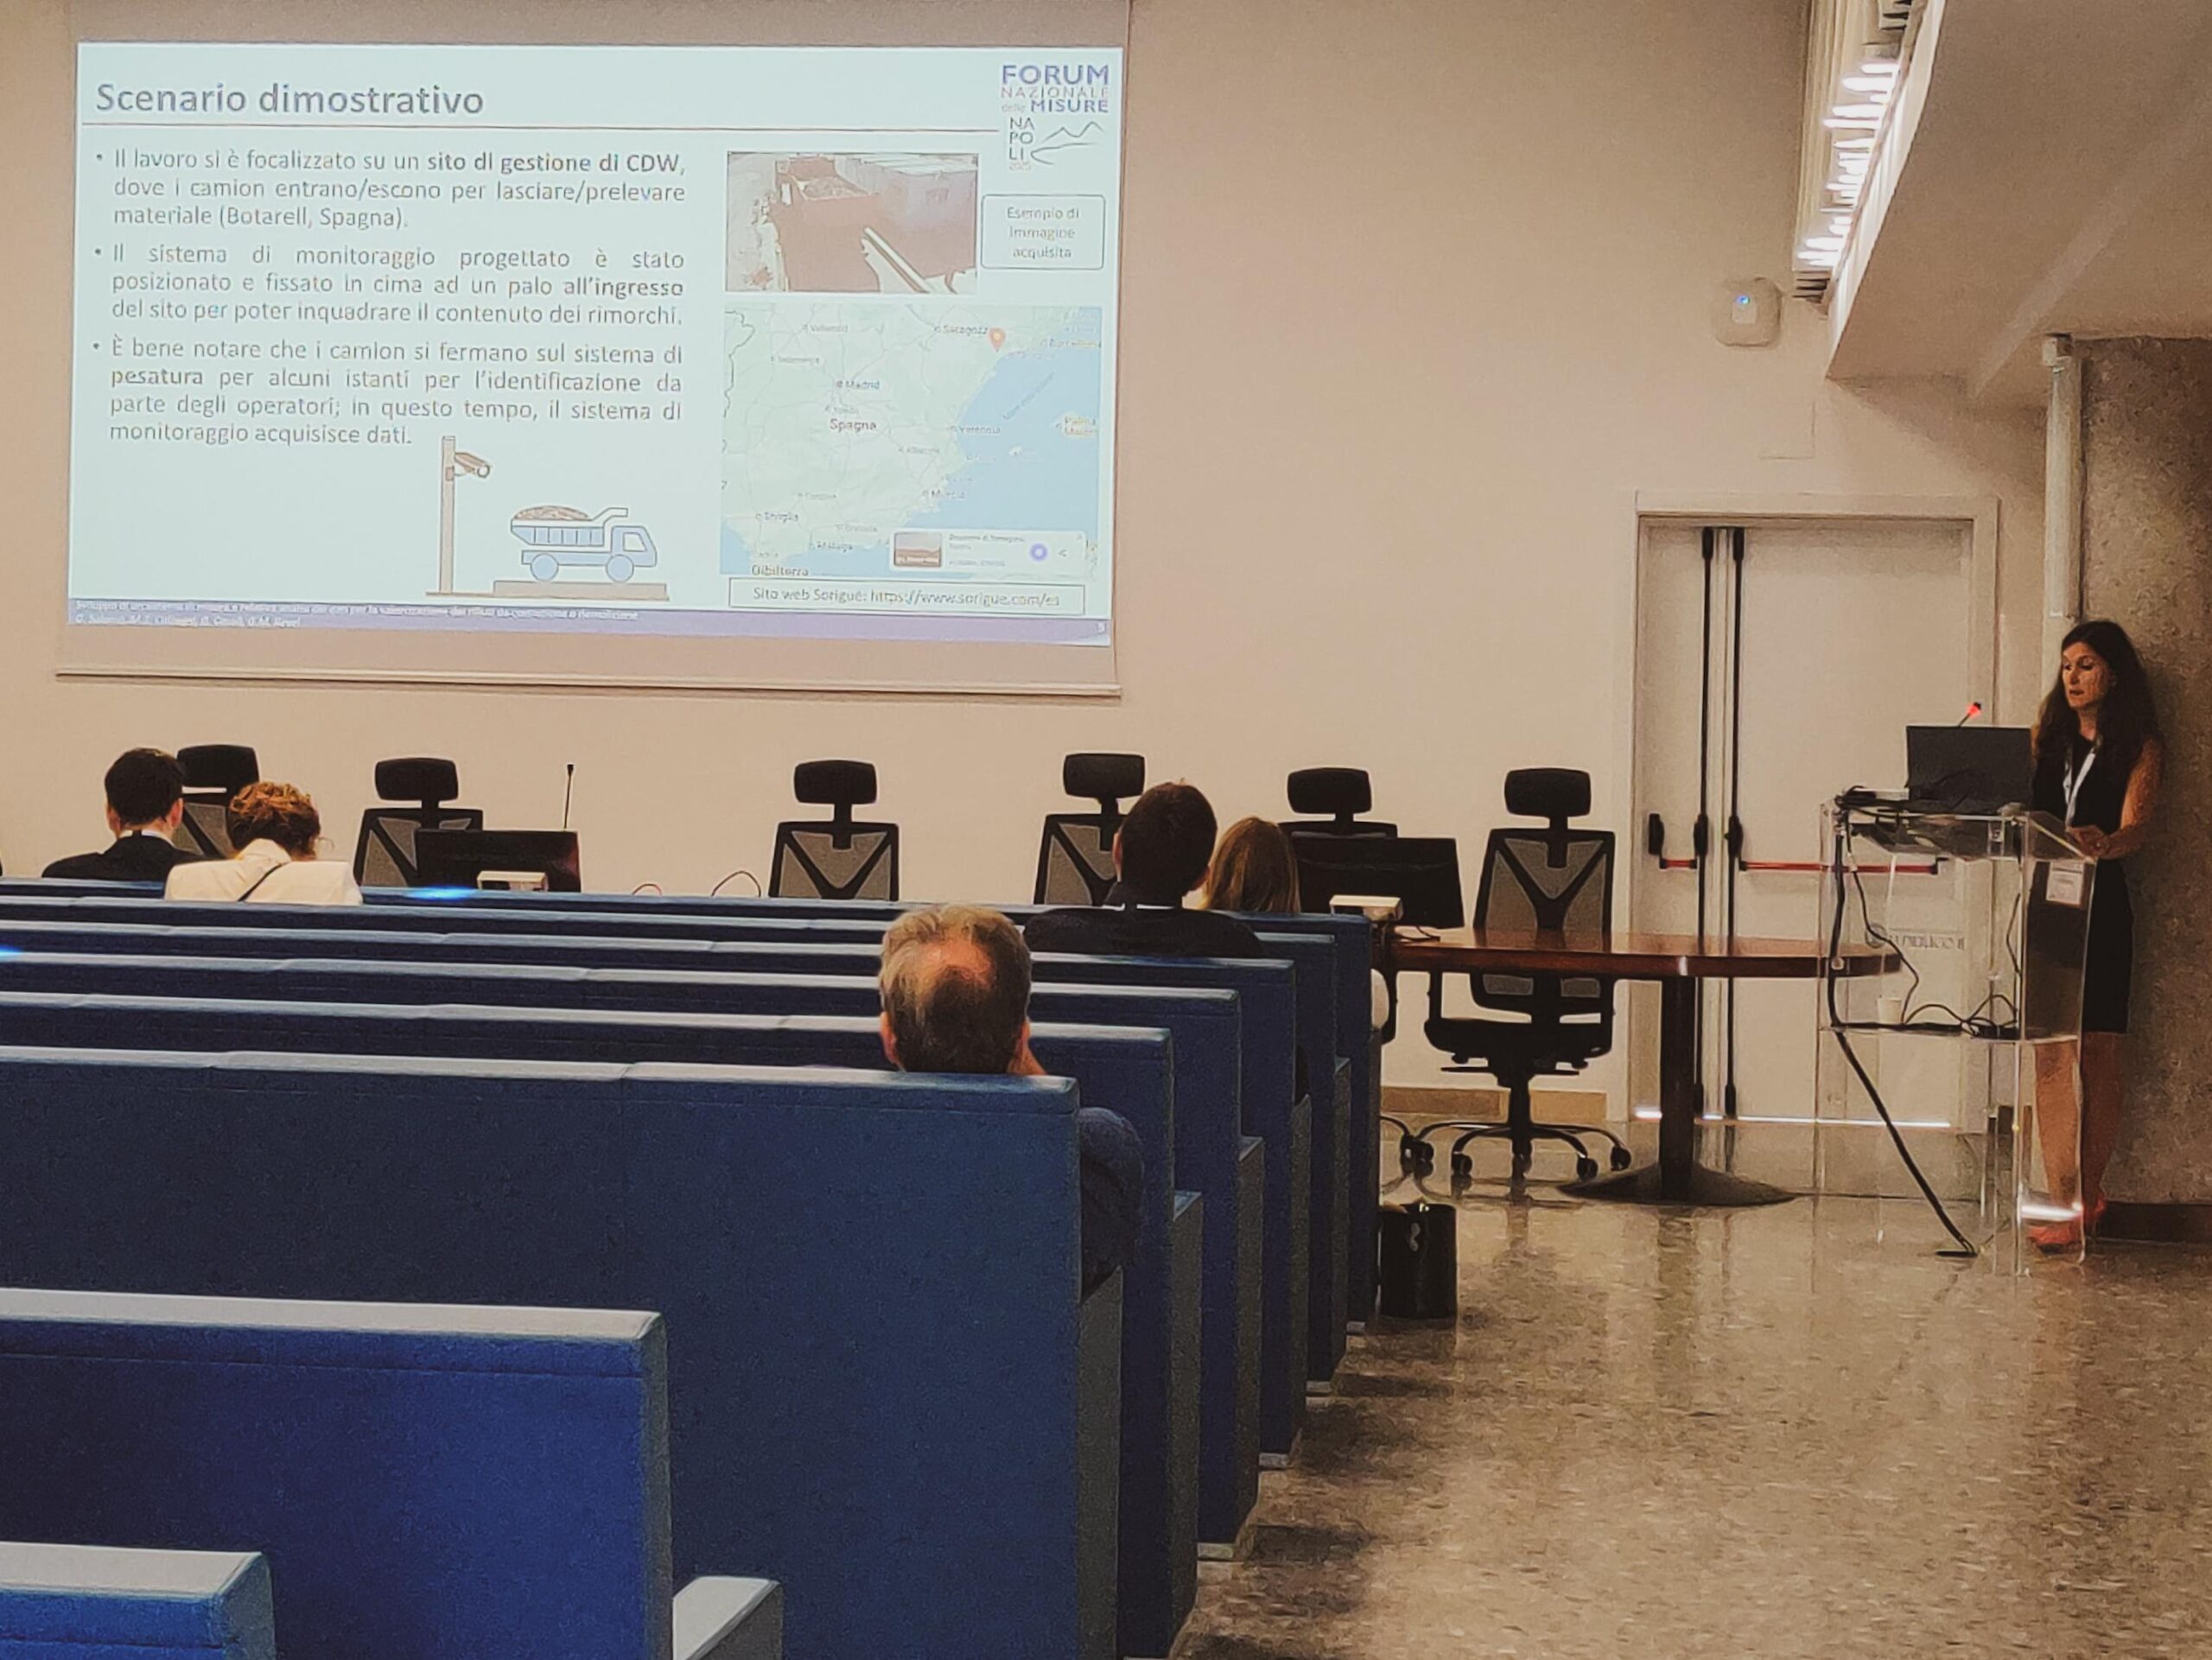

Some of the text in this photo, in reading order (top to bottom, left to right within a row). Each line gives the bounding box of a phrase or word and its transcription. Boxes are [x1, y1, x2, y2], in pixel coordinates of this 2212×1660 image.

[1002, 65, 1109, 85] FORUM
[96, 84, 484, 114] Scenario dimostrativo
[1001, 86, 1109, 99] NAZIONALE
[1031, 99, 1109, 112] MISURE
[1010, 117, 1035, 130] NA
[1009, 131, 1033, 144] PO
[115, 149, 684, 177] Il lavoro si è focalizzato su un sito di gestione di CDW,
[1009, 147, 1025, 161] LI
[115, 176, 164, 196] dove
[190, 179, 264, 197] camion
[276, 178, 441, 203] entrano/escono
[452, 185, 486, 203] per
[498, 180, 684, 206] lasciare/prelevare
[114, 205, 408, 231] materiale (Botarell, Spagna).
[1007, 207, 1079, 220] Esempio di
[113, 243, 683, 271] Il sistema di monitoraggio progettato è stato
[1013, 245, 1072, 259] acquisita
[113, 272, 231, 296] posizionato
[242, 277, 255, 291] e
[266, 272, 333, 292] fissato
[344, 275, 362, 293] in
[374, 276, 422, 294] cima
[433, 275, 459, 294] ad
[471, 280, 497, 295] un
[509, 276, 552, 300] palo
[112, 299, 681, 326] del sito per poter inquadrare il contenuto dei rimorchi.
[112, 334, 124, 356] È
[133, 337, 183, 357] bene
[194, 340, 261, 359] notare
[270, 340, 306, 359] che
[330, 342, 404, 360] camion
[414, 343, 429, 360] si
[440, 342, 527, 362] fermano
[537, 343, 564, 363] sul
[575, 346, 653, 364] sistema
[663, 346, 683, 365] di
[111, 366, 203, 390] pesatura
[219, 372, 254, 390] per
[269, 367, 329, 387] alcuni
[346, 370, 410, 388] istanti
[425, 374, 461, 393] per
[656, 372, 682, 392] da
[111, 394, 681, 423] parte degli operatori; in questo tempo, il sistema di
[111, 422, 411, 448] monitoraggio acquisisce dati.
[830, 418, 877, 432] Spagna
[753, 588, 779, 600] Sito
[783, 589, 810, 601] web
